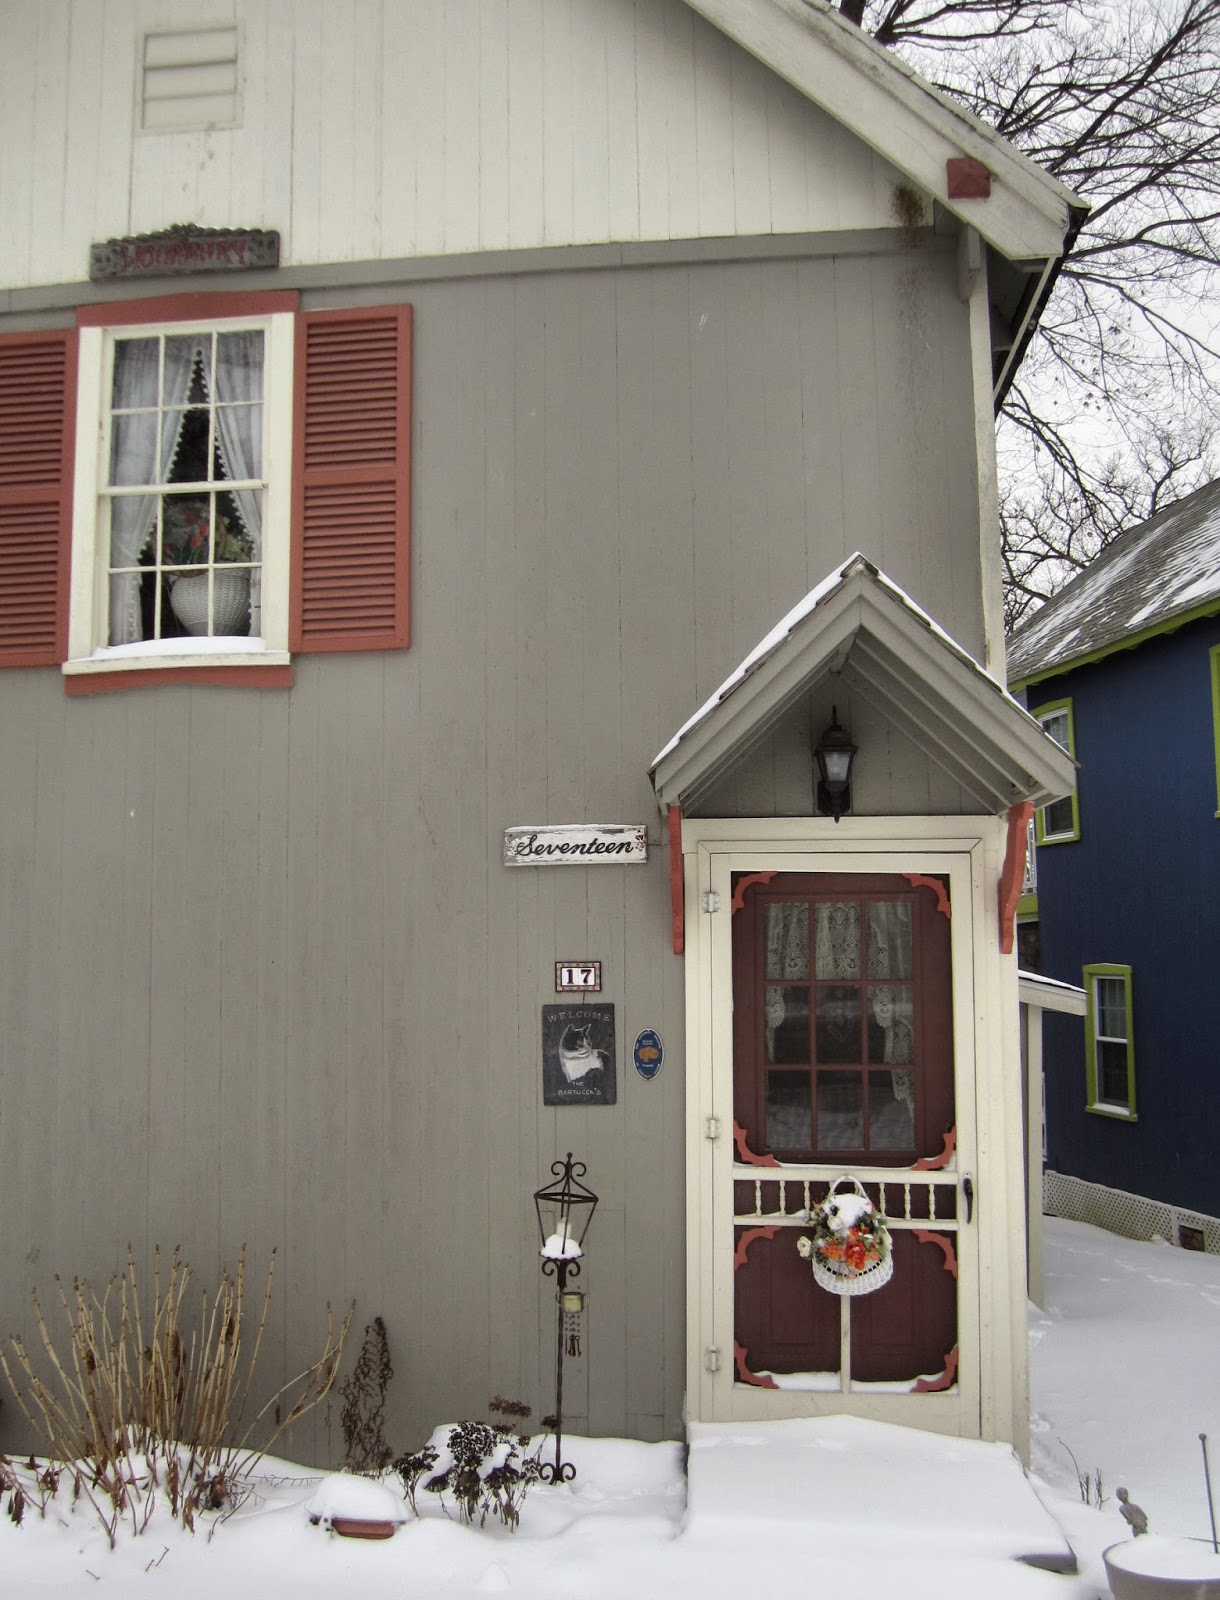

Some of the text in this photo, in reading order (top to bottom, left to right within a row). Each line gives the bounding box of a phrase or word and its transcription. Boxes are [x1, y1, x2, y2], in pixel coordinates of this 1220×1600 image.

[515, 834, 634, 856] Seventeen
[566, 968, 592, 985] 17
[547, 1010, 611, 1022] WELCOME
